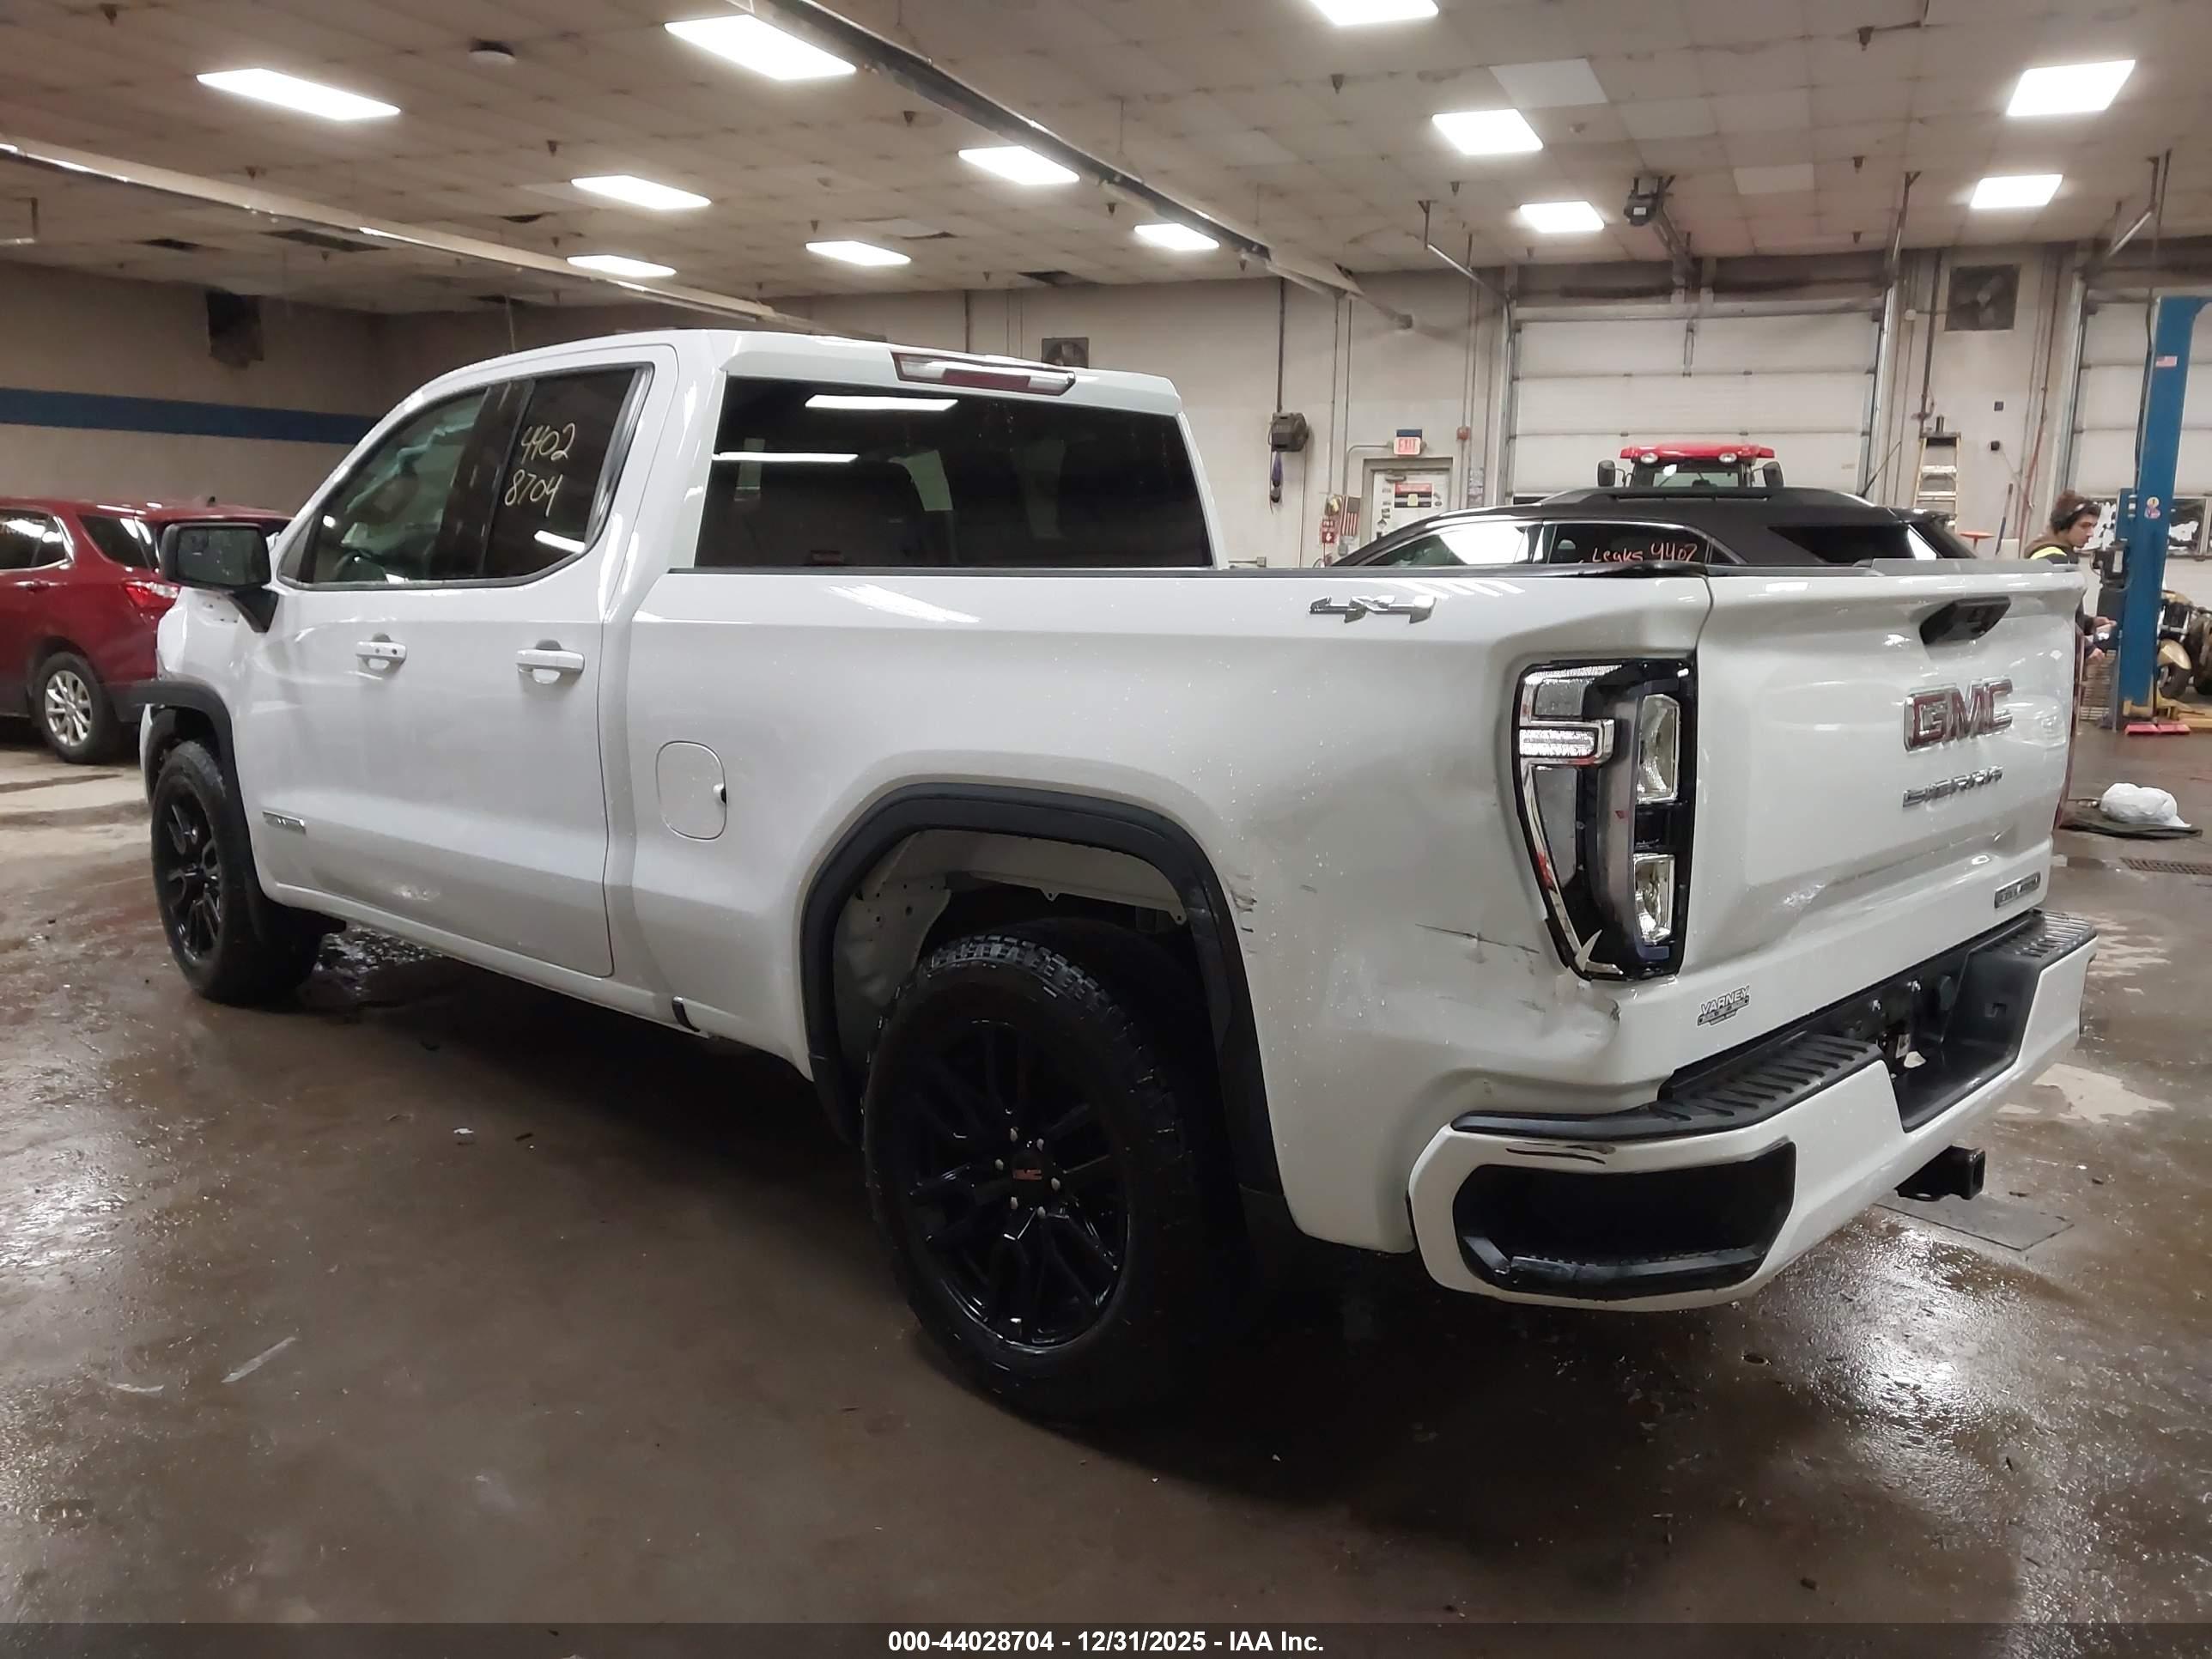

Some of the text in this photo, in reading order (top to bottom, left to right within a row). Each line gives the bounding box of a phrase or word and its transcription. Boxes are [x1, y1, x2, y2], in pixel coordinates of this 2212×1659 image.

[520, 422, 576, 465] 4402
[1398, 438, 1417, 453] EXIT
[504, 469, 563, 517] 8704
[1903, 676, 2014, 752] GMC
[1700, 984, 1750, 1015] VARNEY
